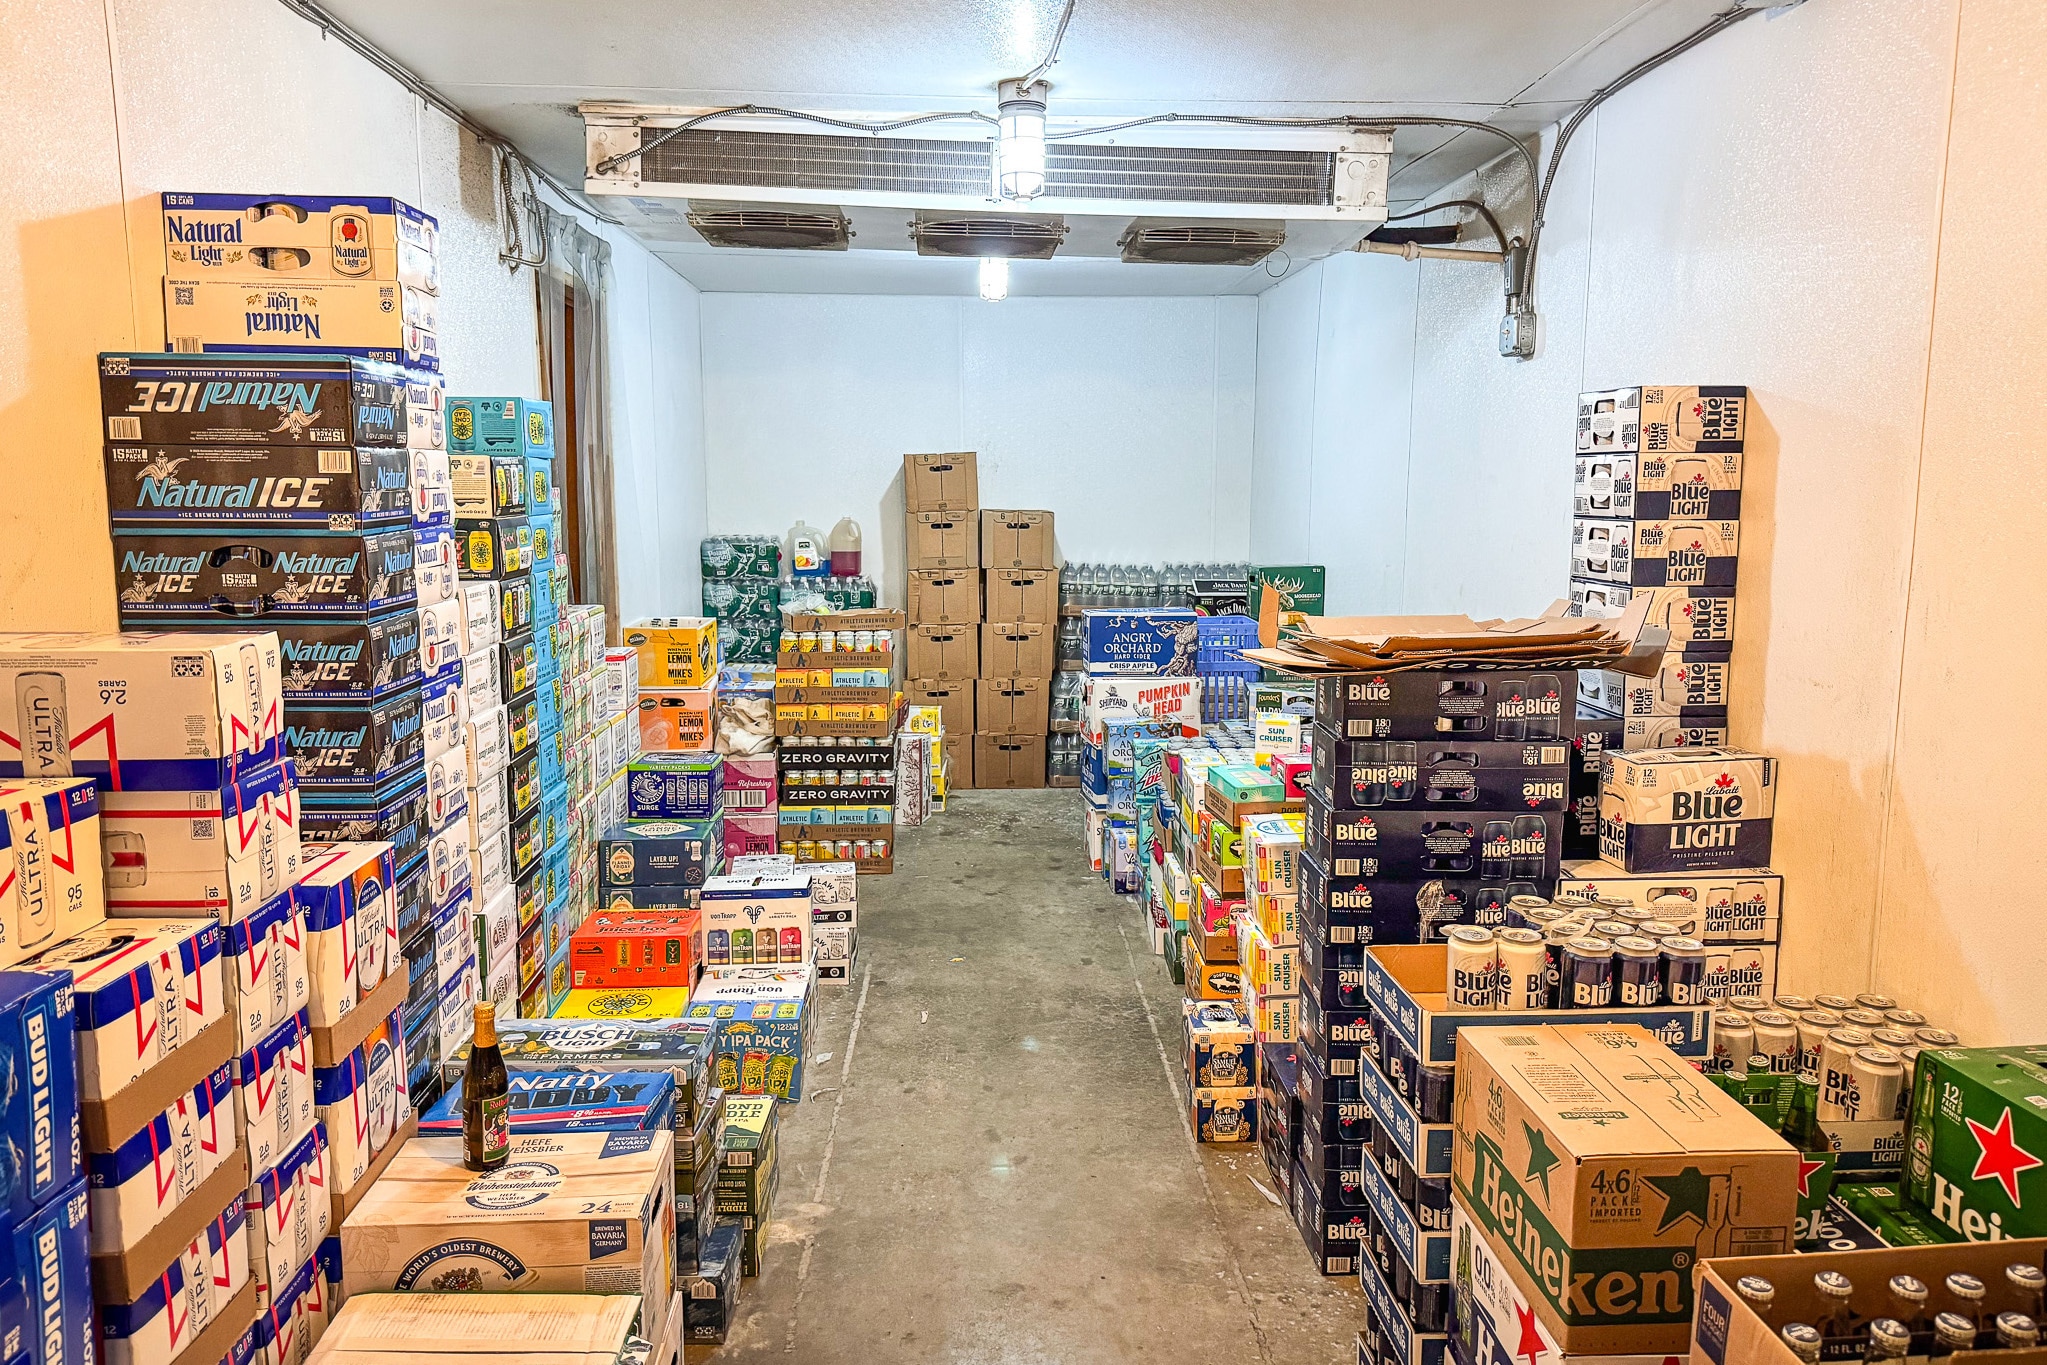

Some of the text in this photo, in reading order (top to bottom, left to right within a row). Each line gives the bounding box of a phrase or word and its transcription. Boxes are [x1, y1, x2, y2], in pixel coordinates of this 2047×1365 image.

[167, 195, 177, 205] 15
[167, 216, 242, 243] Natural
[191, 246, 222, 266] Light
[335, 245, 368, 258] Natural
[344, 258, 360, 267] Light
[265, 292, 298, 311] Light
[246, 312, 321, 339] Natural
[129, 382, 321, 413] Natural ICE
[1703, 398, 1722, 440] Blue
[1722, 399, 1738, 439] LIGHT
[1644, 461, 1666, 470] Blue
[1643, 470, 1665, 478] LIGHT
[136, 477, 330, 508] Natural ICE
[1672, 484, 1709, 499] Blue
[1671, 502, 1708, 515] LIGHT
[122, 551, 206, 573] Natural
[272, 552, 360, 573] Natural
[384, 551, 413, 574] Natural
[1668, 551, 1705, 566] Blue
[222, 574, 233, 584] 15
[1667, 568, 1704, 581] LIGHT
[155, 575, 198, 593] ICE
[308, 576, 351, 593] ICE
[1113, 633, 1152, 643] ANGRY
[282, 640, 364, 662] Natural
[1104, 644, 1161, 653] ORCHARD
[668, 655, 691, 663] LEMON
[314, 664, 356, 680] ICE
[668, 670, 692, 678] MIKE'S
[1348, 685, 1390, 700] Blue
[1687, 664, 1705, 705] Blue
[1707, 665, 1721, 704] LIGHT
[100, 689, 127, 704] 2.6
[247, 665, 259, 726] ULTRA
[1139, 682, 1190, 704] PUMPKIN
[1099, 698, 1127, 708] SHIPYARD
[1154, 699, 1182, 715] HEAD
[1526, 699, 1560, 714] Blue
[392, 711, 421, 743] Natural
[679, 719, 703, 727] LEMON
[34, 697, 54, 769] ULTRA
[285, 726, 367, 747] Natural
[680, 733, 703, 741] MIKE'S
[316, 749, 357, 766] ICE
[782, 754, 889, 763] ZERO GRAVITY
[1643, 769, 1653, 777] 12
[738, 780, 772, 788] Refreshing
[1523, 783, 1563, 798] Blue
[1704, 786, 1741, 795] Labatt
[72, 787, 94, 802] 12 12
[789, 790, 889, 799] ZERO GRAVITY
[1672, 792, 1742, 820] Blue
[1336, 825, 1377, 840] Blue
[1670, 823, 1742, 849] LIGHT
[26, 828, 43, 916] ULTRA
[68, 884, 83, 900] 95
[209, 887, 218, 898] 18
[240, 882, 251, 894] 2.6
[69, 902, 83, 912] CALS
[1331, 892, 1372, 908] Blue
[1733, 902, 1766, 917] Blue
[1732, 918, 1766, 930] LIGHT
[358, 917, 384, 949] ULTRA
[1455, 968, 1496, 990] Blue
[54, 990, 62, 1019] CANS
[63, 986, 74, 1012] 15
[537, 1030, 637, 1041] BUSCH
[732, 1036, 790, 1048] IPA PACK
[509, 1074, 614, 1090] Natty
[1943, 1082, 1960, 1102] 12
[27, 1016, 50, 1191] BUD LIGHT
[69, 1114, 80, 1141] 16
[1873, 1138, 1904, 1150] Blue
[467, 1181, 561, 1191] Weihenstephaner
[1590, 1168, 1630, 1193] 4x6
[579, 1201, 612, 1214] 24
[1590, 1208, 1641, 1218] IMPORTED
[1480, 1149, 1684, 1316] Heineken
[405, 1242, 520, 1283] WORLD'S OLDEST BREWERY
[1703, 1299, 1725, 1329] FOUR
